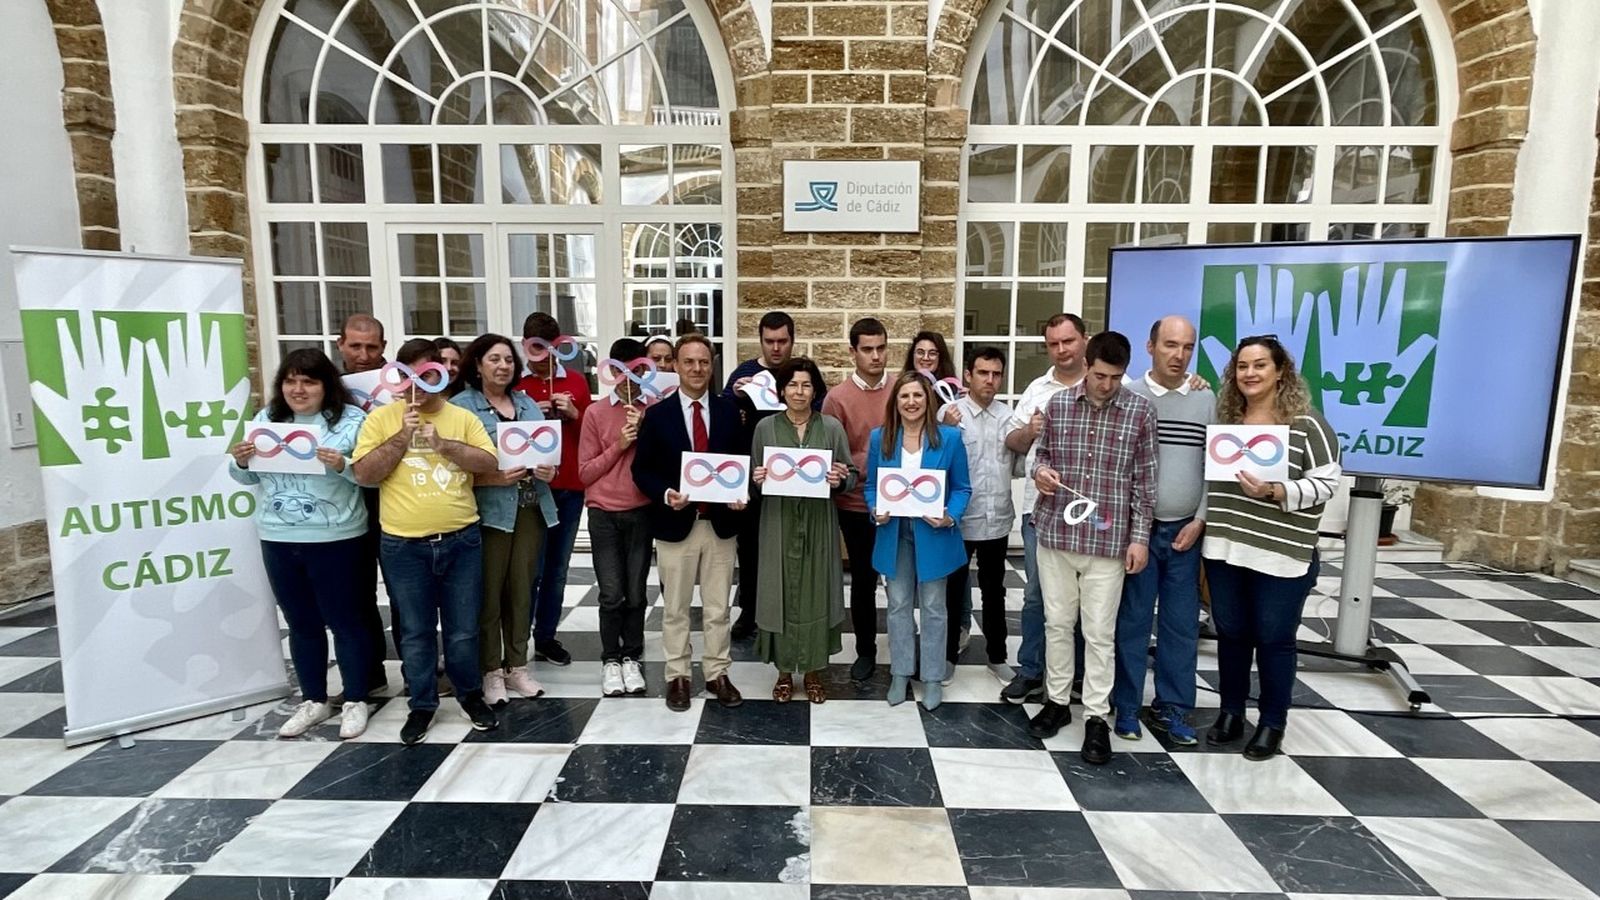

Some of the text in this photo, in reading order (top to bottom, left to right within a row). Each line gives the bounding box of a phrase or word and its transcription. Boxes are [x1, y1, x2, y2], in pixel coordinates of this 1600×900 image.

[846, 181, 912, 197] Diputación
[847, 200, 900, 212] de Cádiz
[60, 491, 256, 537] AUTISMO
[102, 548, 233, 591] CÁDIZ
